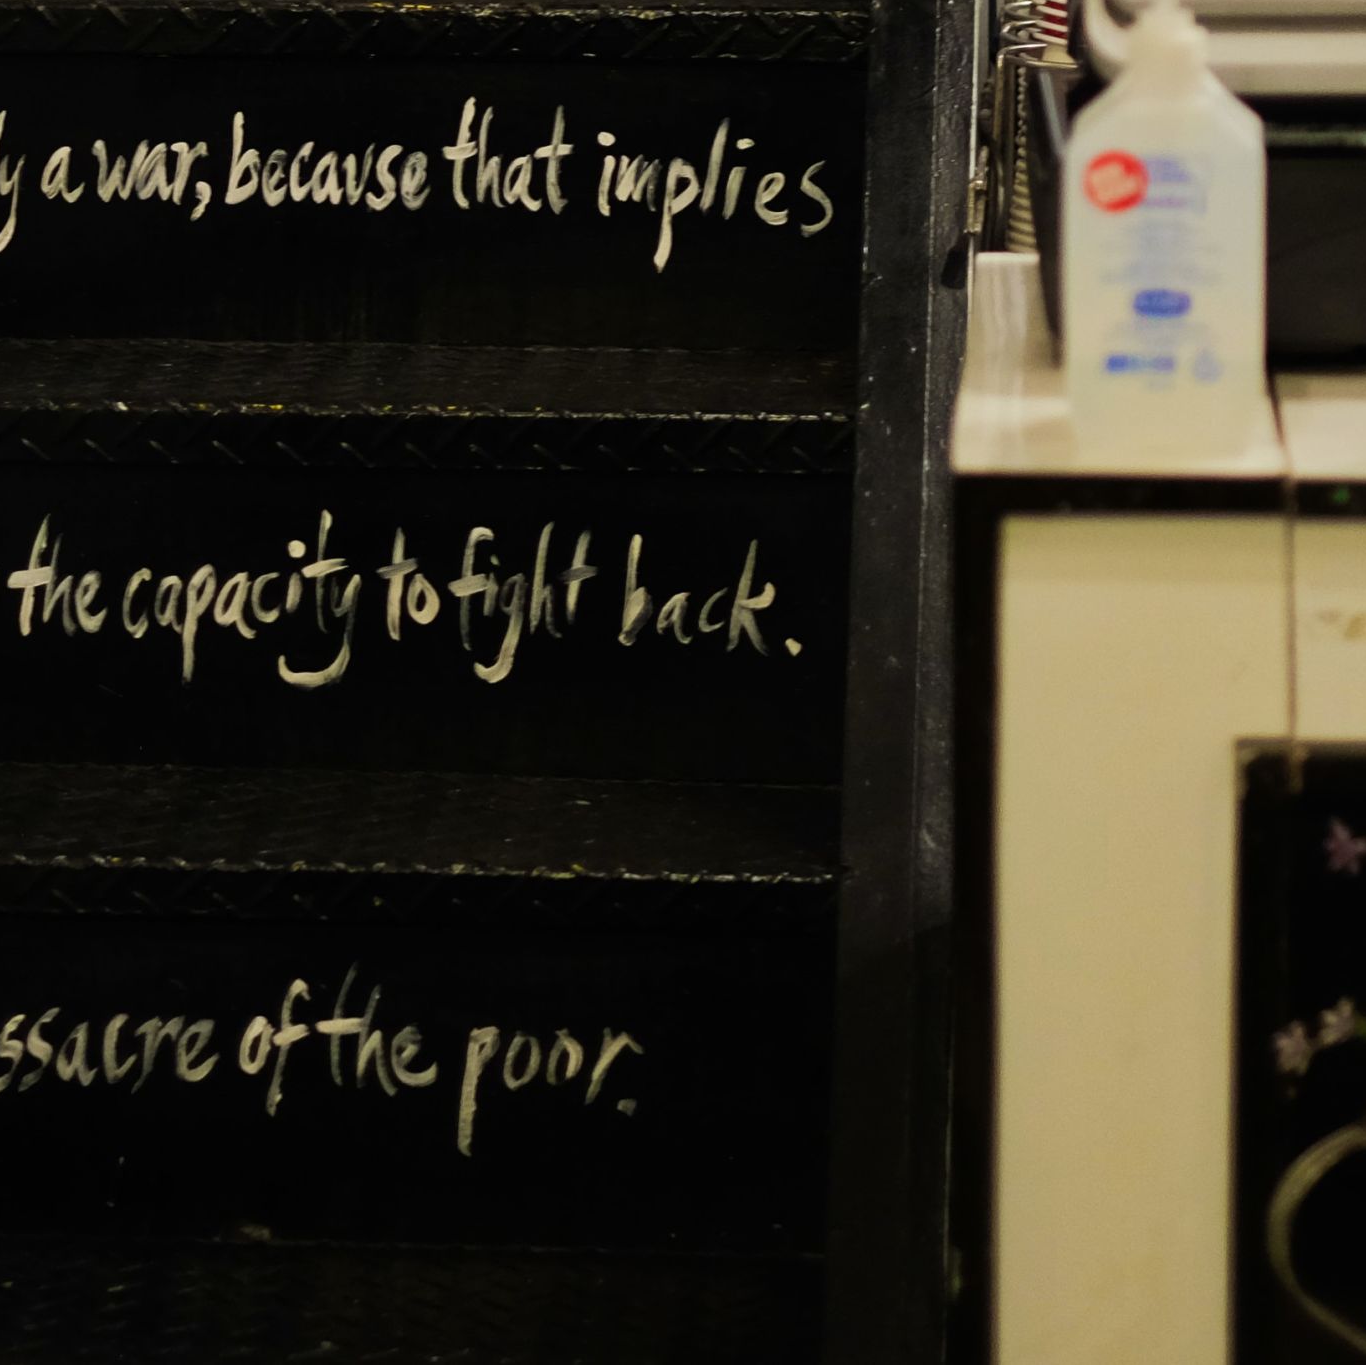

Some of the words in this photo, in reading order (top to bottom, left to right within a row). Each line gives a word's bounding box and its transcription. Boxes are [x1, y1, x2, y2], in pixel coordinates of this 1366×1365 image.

[41, 145, 85, 204] a
[90, 139, 213, 222] war,
[224, 111, 432, 212] because
[442, 96, 574, 215] that
[596, 117, 836, 274] implies
[6, 513, 109, 638] the
[122, 508, 363, 688] capacity
[376, 527, 441, 642] to
[447, 520, 599, 684] fight
[618, 533, 803, 658] back.
[238, 978, 311, 1118] of
[314, 961, 438, 1098] the
[457, 1025, 645, 1157] poor.
